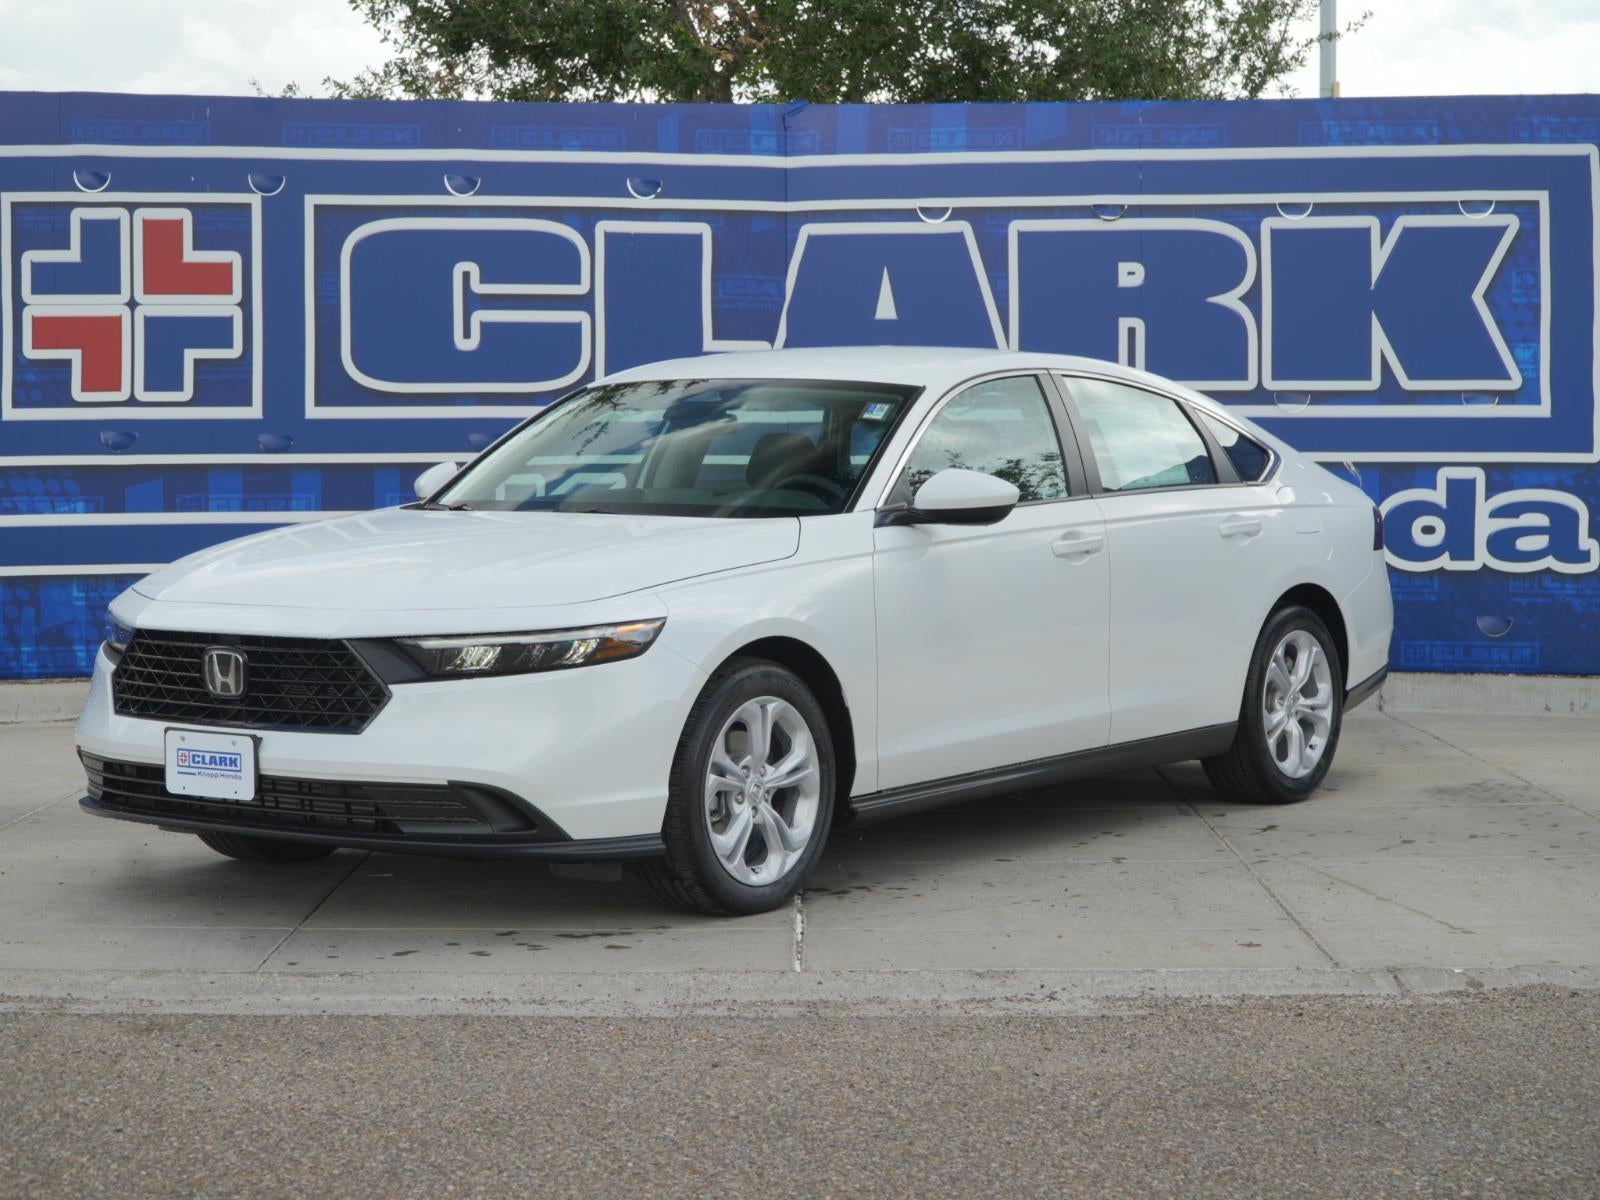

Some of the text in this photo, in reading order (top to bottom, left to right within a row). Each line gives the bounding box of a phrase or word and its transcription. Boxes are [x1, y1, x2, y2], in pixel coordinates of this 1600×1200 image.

[340, 213, 1522, 393] CLARK
[191, 754, 238, 768] CLARK
[197, 770, 242, 780] Knapp Honda
